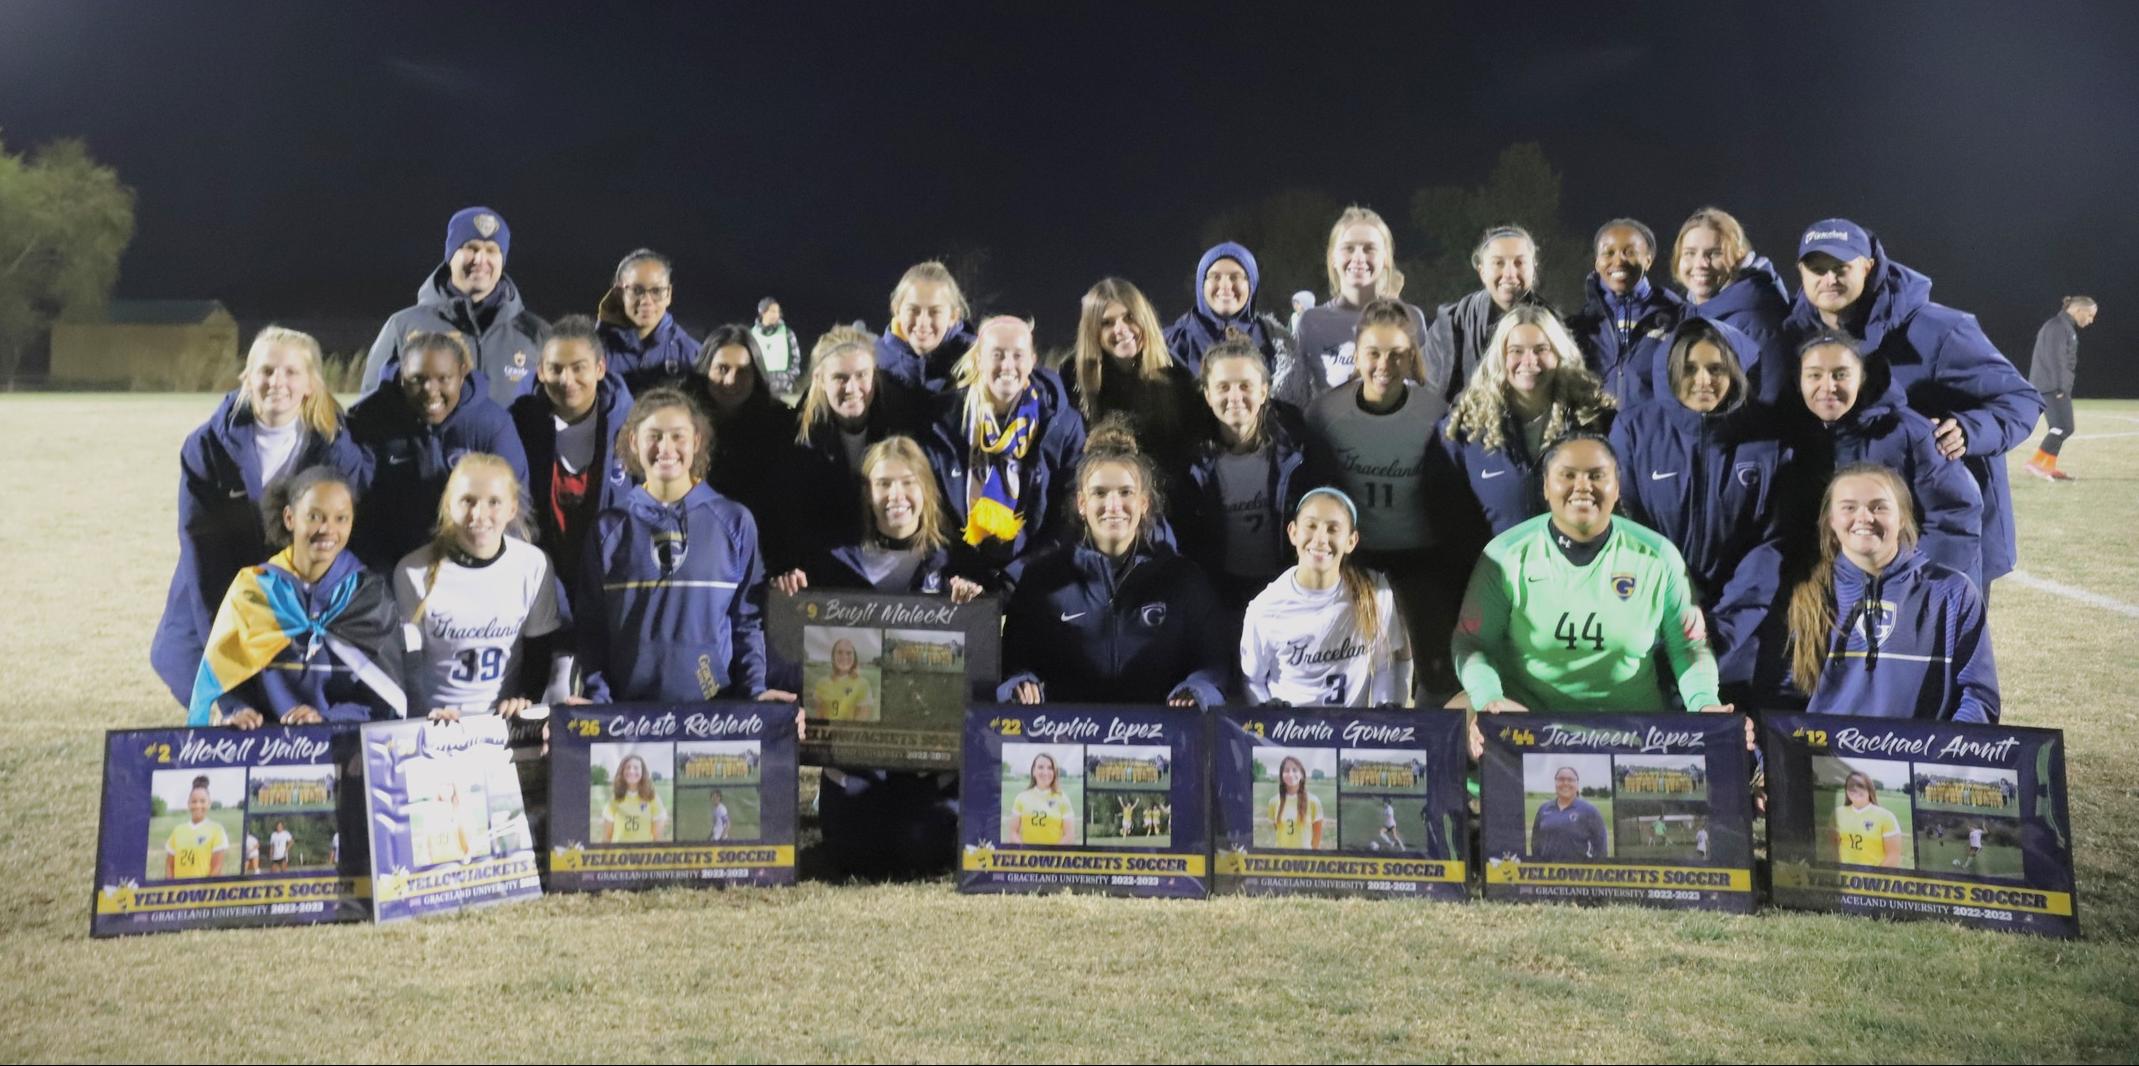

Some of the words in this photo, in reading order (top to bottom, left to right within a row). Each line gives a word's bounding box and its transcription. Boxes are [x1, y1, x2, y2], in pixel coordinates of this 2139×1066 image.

[1366, 482, 1393, 508] 11
[1243, 514, 1264, 533] 7
[431, 611, 525, 640] Graceland
[1554, 611, 1604, 651] 44
[1286, 635, 1366, 666] Gracelan
[452, 646, 503, 683] 39
[1324, 673, 1347, 704] 3
[568, 717, 600, 737] #26
[608, 712, 680, 737] Celeste
[684, 712, 763, 738] Robledo
[989, 716, 1022, 736] #22
[1027, 715, 1100, 743] Sophia
[1103, 717, 1163, 745] Lopez
[1272, 719, 1334, 742] Maria
[1342, 720, 1416, 748] Gomez
[1499, 725, 1535, 746] #44
[1539, 724, 1638, 748] Jazmeen
[1640, 725, 1706, 754] Lopez
[1793, 727, 1828, 748] #12
[1835, 727, 1936, 757] Rachael
[144, 742, 172, 763] #2
[624, 815, 640, 832] 26
[1031, 809, 1048, 828] 22
[179, 848, 196, 867] 24
[581, 850, 713, 867] YELLOWJACKETS
[716, 849, 777, 866] SOCCER
[991, 854, 1122, 871] YELLOWJACKETS
[1126, 857, 1188, 872] SOCCER
[1244, 856, 1379, 875] YELLOWJACKETS
[1382, 861, 1446, 878] SOCCER
[597, 871, 648, 881] GRACELAND
[650, 870, 699, 880] UNIVERSITY
[701, 868, 749, 879] 2022-2023
[1007, 873, 1058, 883] GRACELAND
[1059, 874, 1109, 885] UNIVERSITY
[1111, 875, 1159, 886] 2022-2023
[1261, 877, 1313, 888] GRACELAND
[1314, 879, 1365, 890] UNIVERSITY
[1367, 880, 1417, 891] 2022-2023
[1517, 866, 1659, 884] YELLOWJACKETS
[1663, 869, 1731, 887] SOCCER
[134, 884, 285, 907] YELLOWJACKETS
[1535, 886, 1590, 897] GRACELAND
[1591, 888, 1645, 899] UNIVERSITY
[1647, 889, 1701, 900] 2022-2023
[1970, 887, 2048, 909] SOCCER
[151, 907, 210, 922] GRACELAND
[212, 905, 268, 919] UNIVERSITY
[271, 901, 324, 915] 2022-2023
[1889, 899, 1951, 914] UNIVERSITY
[1952, 906, 2013, 922] 2022-2023
